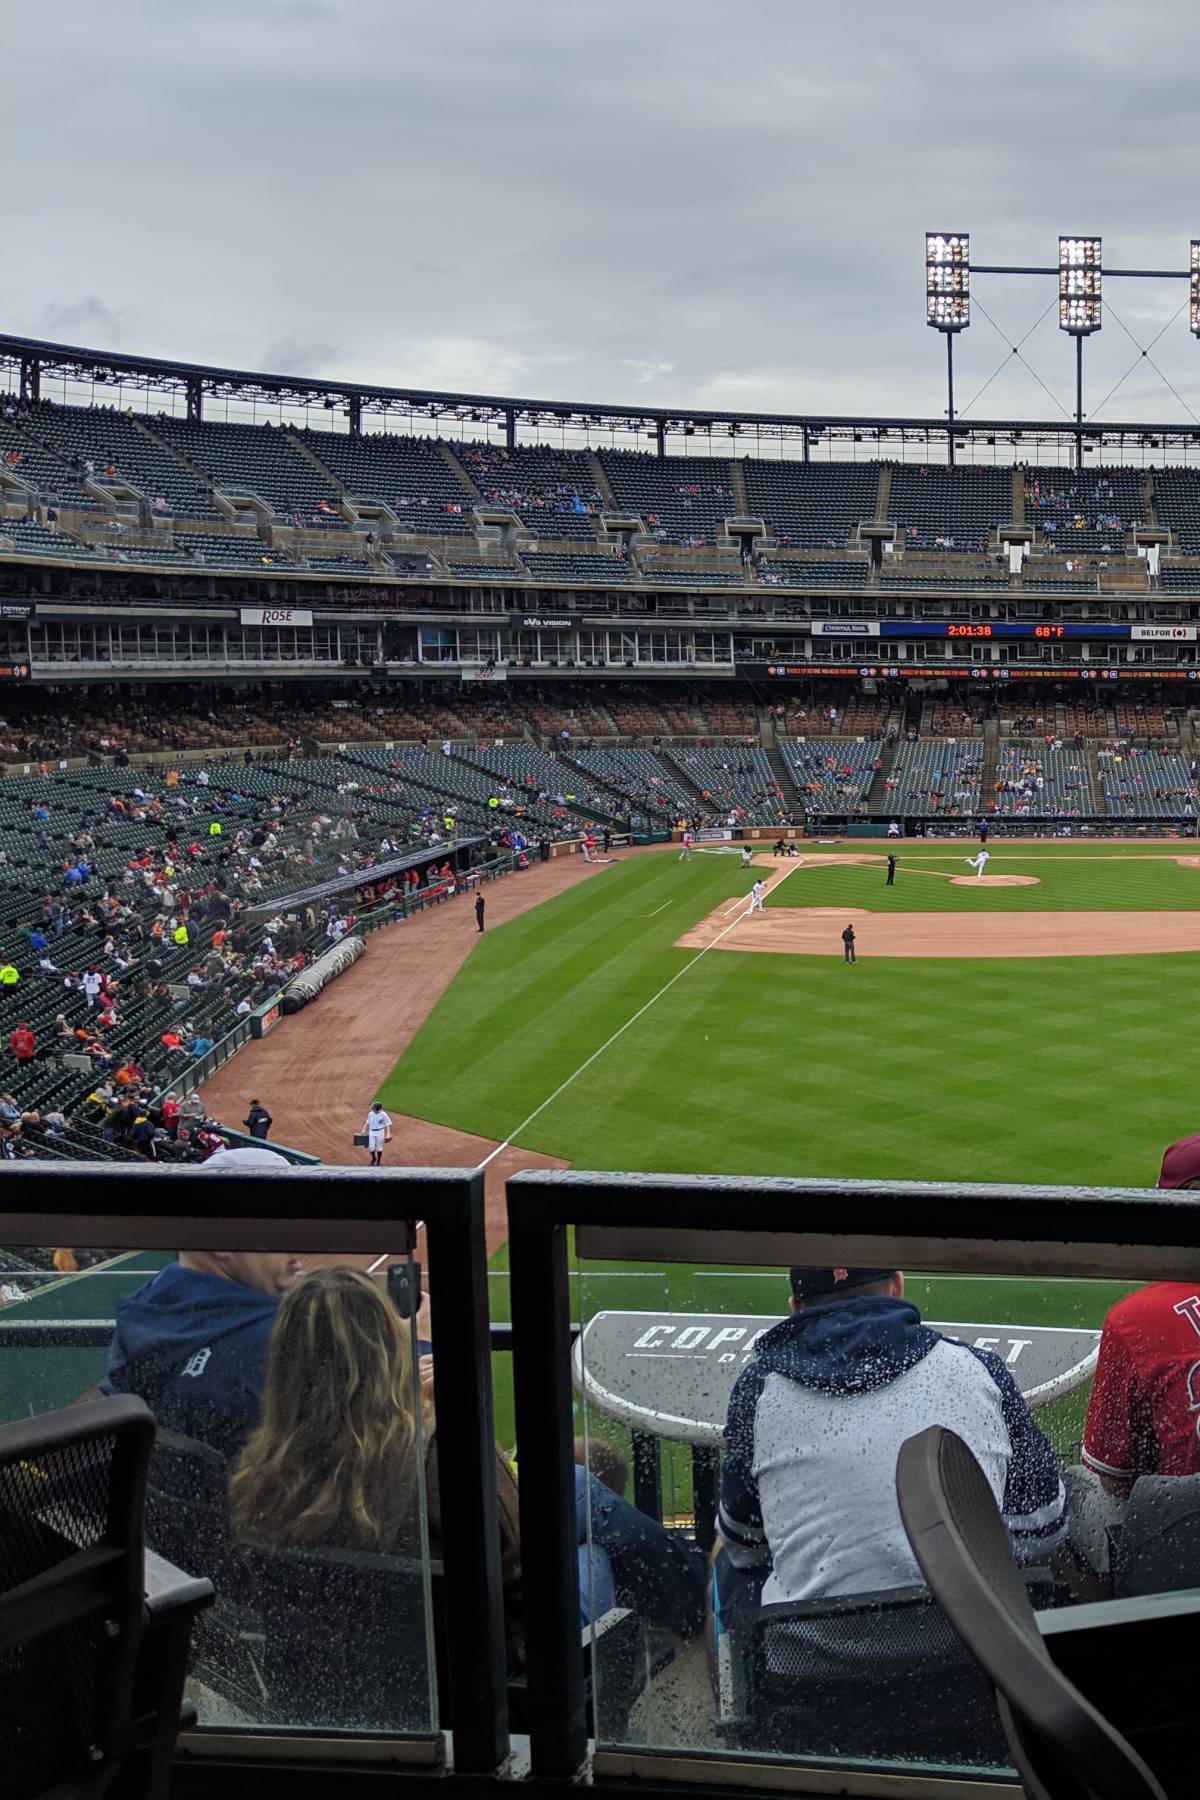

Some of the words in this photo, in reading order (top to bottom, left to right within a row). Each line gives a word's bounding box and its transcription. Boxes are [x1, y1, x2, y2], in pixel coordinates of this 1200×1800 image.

[2, 606, 31, 615] DETROIT
[262, 610, 293, 624] ROSE
[948, 626, 992, 636] 2:01:38
[1141, 629, 1171, 637] BELFOR
